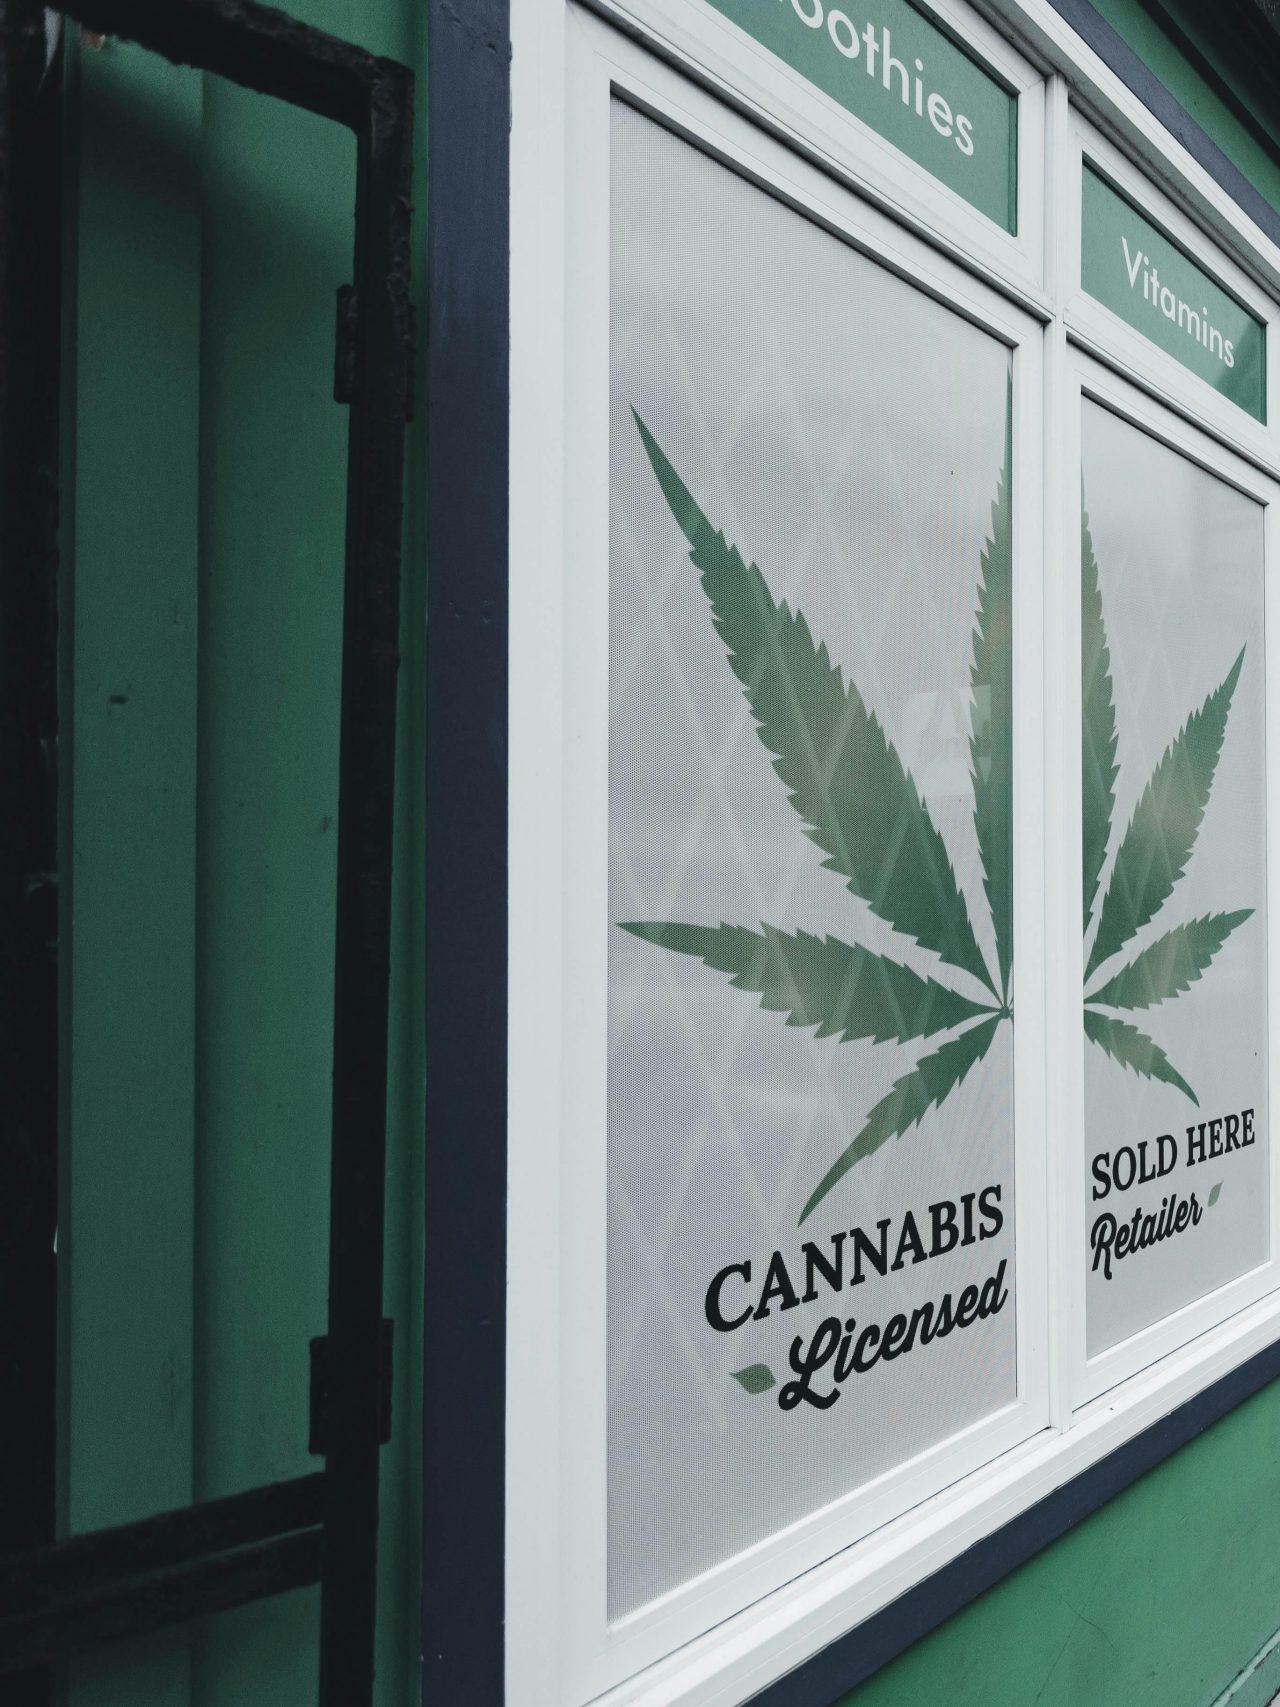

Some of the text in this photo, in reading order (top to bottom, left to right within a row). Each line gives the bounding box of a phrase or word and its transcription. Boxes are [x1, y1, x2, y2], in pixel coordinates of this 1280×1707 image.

[778, 0, 974, 156] oothies
[1121, 235, 1235, 368] Vitamins
[705, 1108, 1255, 1333] CANNABIS SOLD HERE
[778, 1192, 1203, 1411] Licensed Retailer
